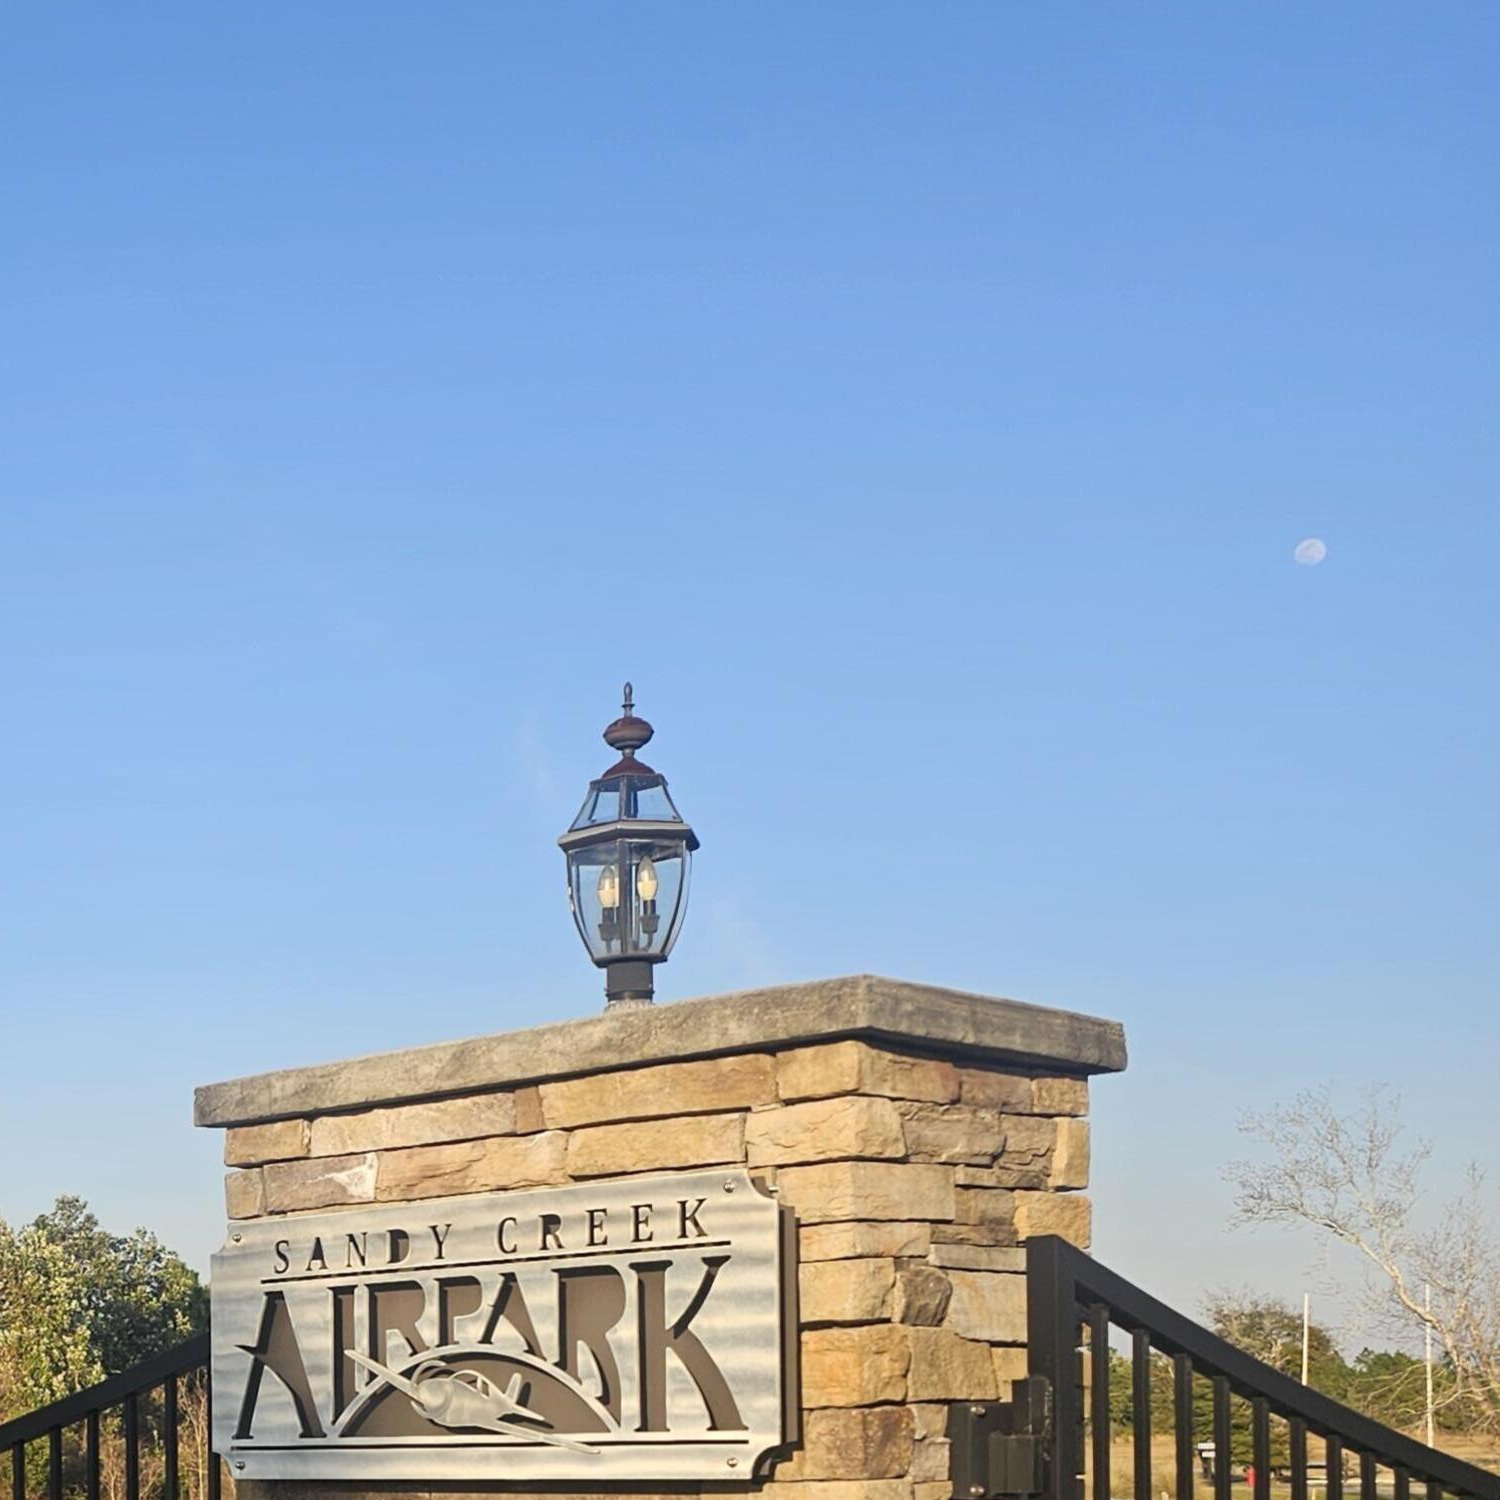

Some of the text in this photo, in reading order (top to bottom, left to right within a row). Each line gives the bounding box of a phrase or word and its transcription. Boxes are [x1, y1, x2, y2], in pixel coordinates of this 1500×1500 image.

[273, 1197, 709, 1275] SANDY CREEK
[231, 1254, 749, 1439] AIRPARK
